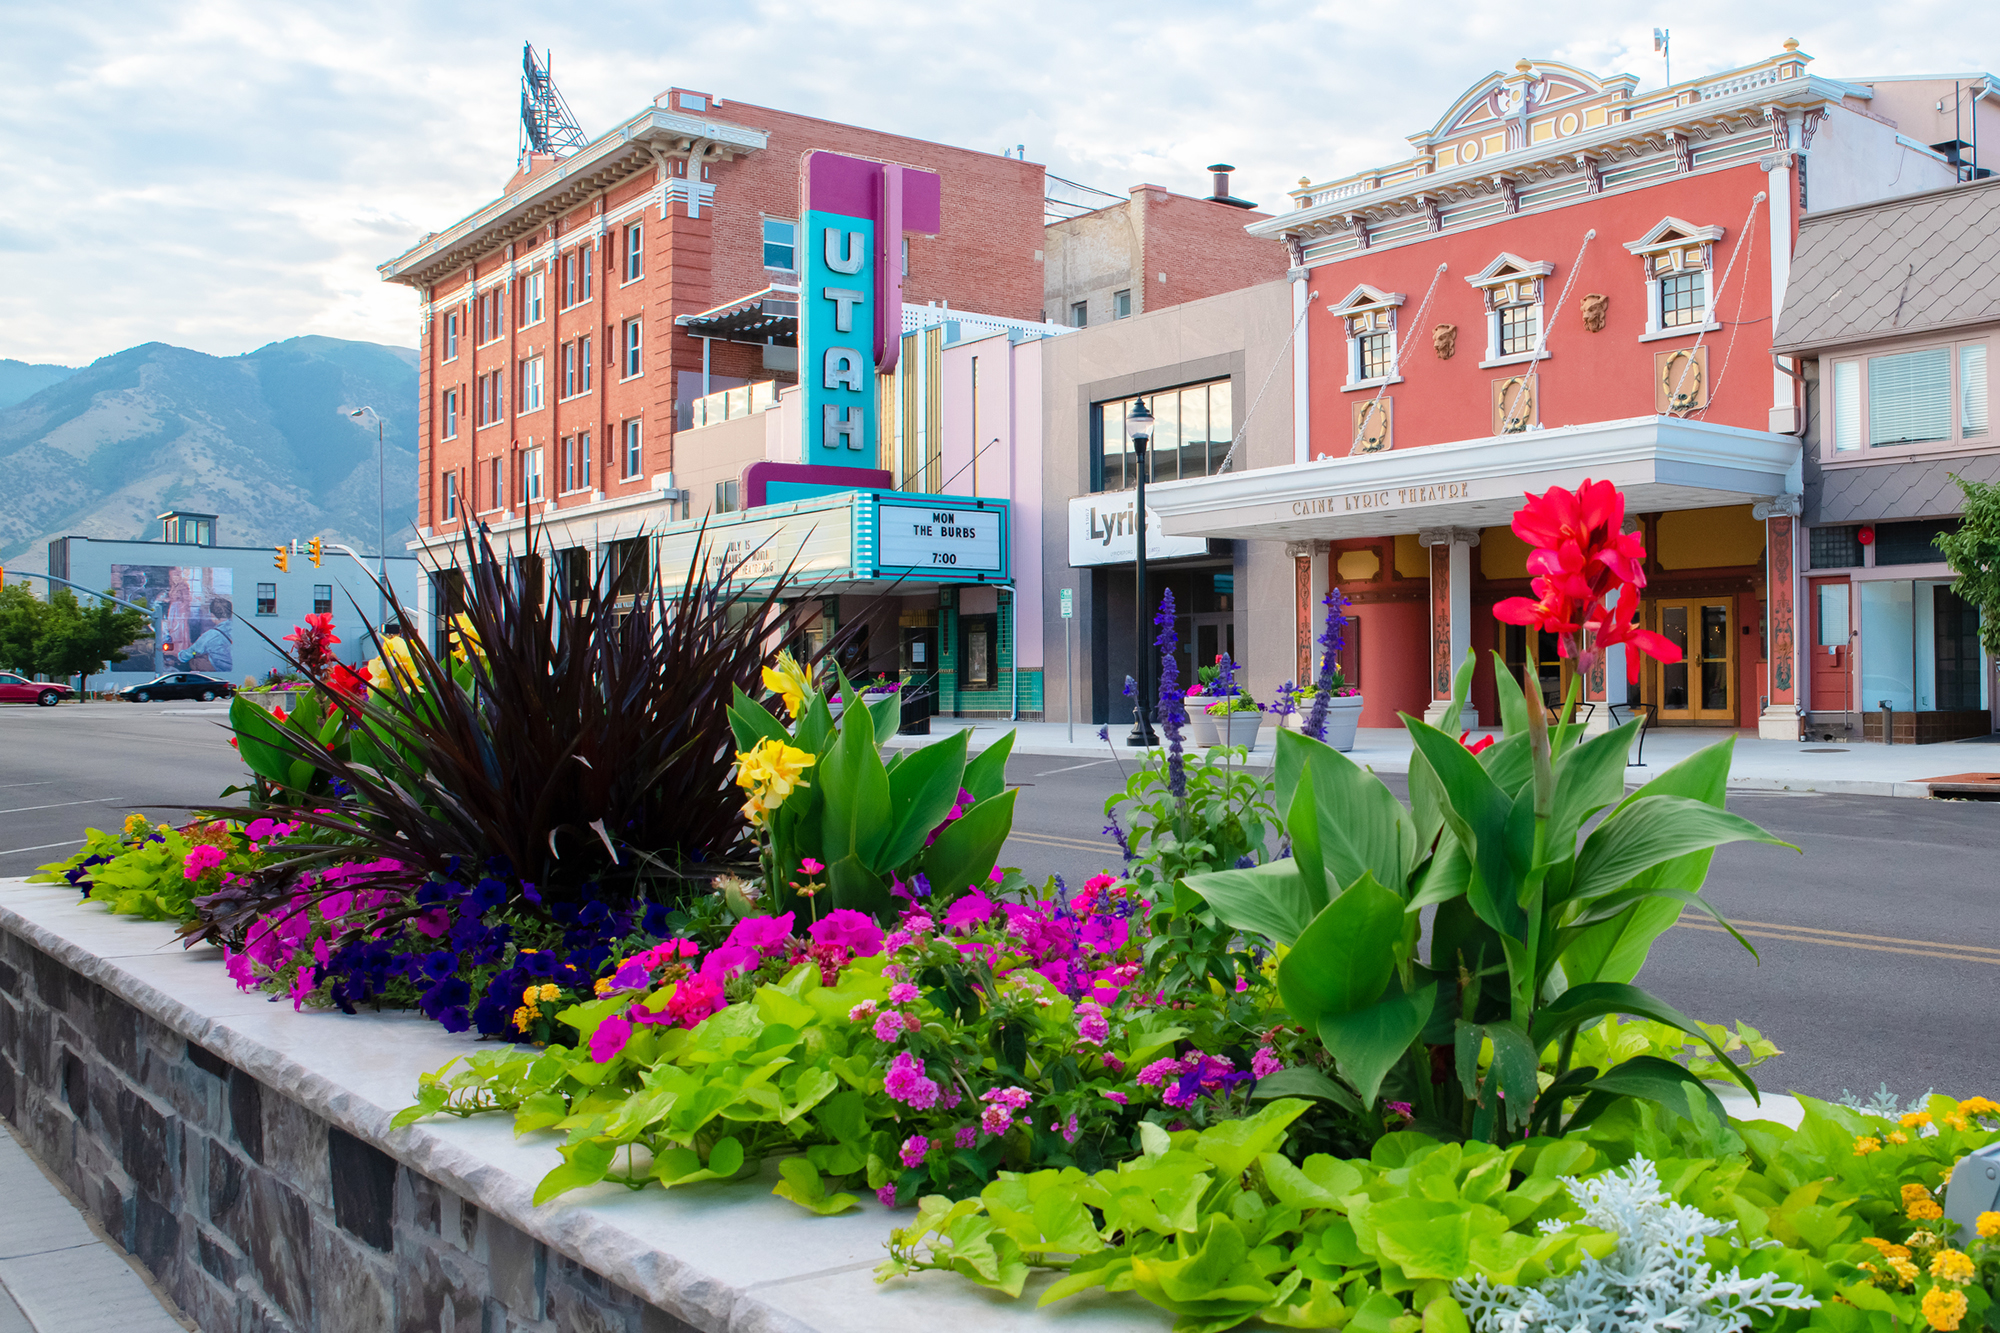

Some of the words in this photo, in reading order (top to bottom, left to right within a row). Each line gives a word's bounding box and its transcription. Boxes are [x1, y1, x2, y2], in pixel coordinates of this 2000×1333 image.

[824, 227, 865, 450] UTAH
[1292, 498, 1334, 516] CAINE
[1344, 491, 1389, 511] LYRIC
[1398, 482, 1468, 504] THEATRE
[932, 512, 955, 524] MON
[913, 525, 933, 536] THE
[941, 526, 976, 538] BURBS
[728, 541, 741, 553] JULY
[745, 540, 751, 550] IS
[723, 553, 741, 564] ANKS
[932, 552, 957, 564] 7:00
